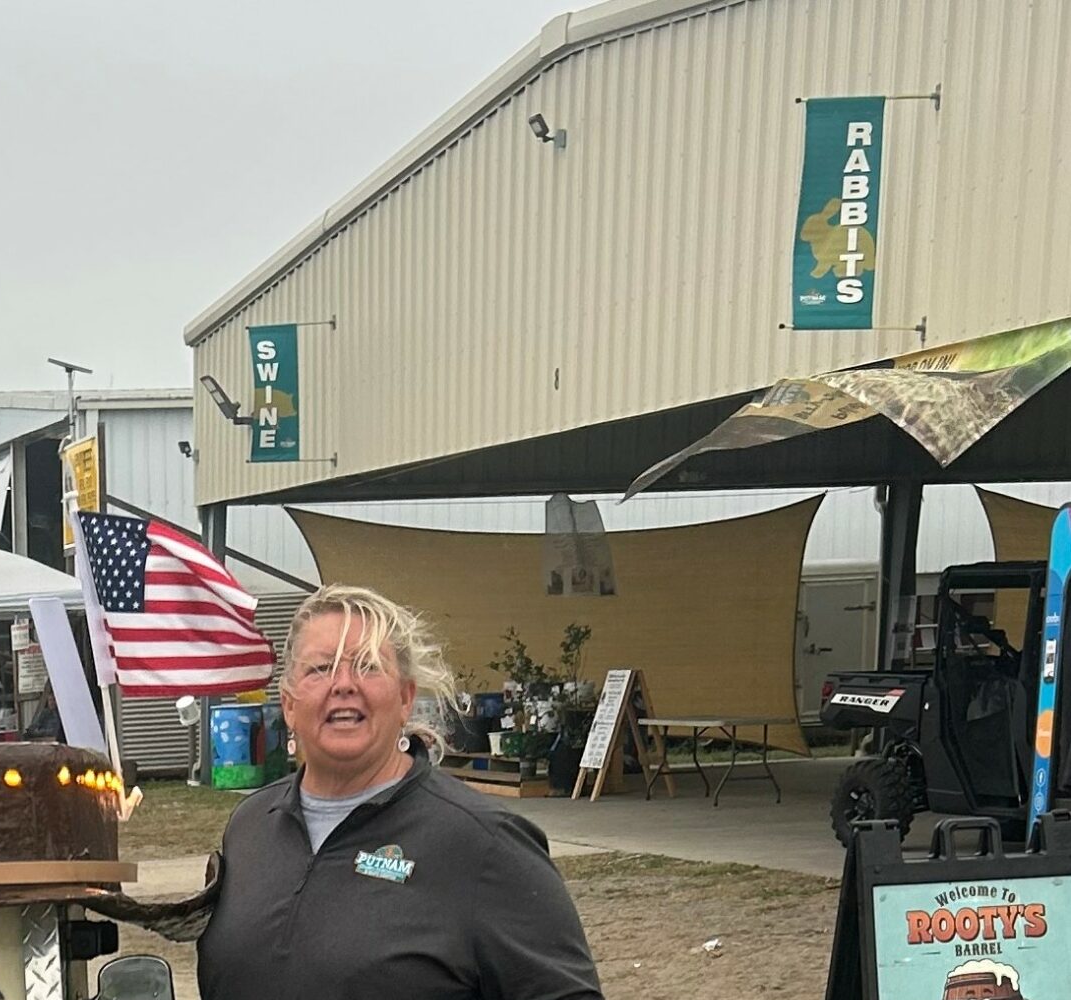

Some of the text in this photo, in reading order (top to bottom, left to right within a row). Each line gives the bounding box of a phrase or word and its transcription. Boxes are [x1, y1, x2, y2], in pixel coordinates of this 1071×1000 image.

[836, 121, 874, 304] RABBITS
[256, 340, 279, 448] SWINE
[839, 695, 890, 706] RANGER
[356, 852, 415, 877] PUTNAM
[934, 886, 1016, 907] Welcome To
[906, 904, 1047, 943] ROOTY'S
[955, 942, 1003, 957] BARREL
